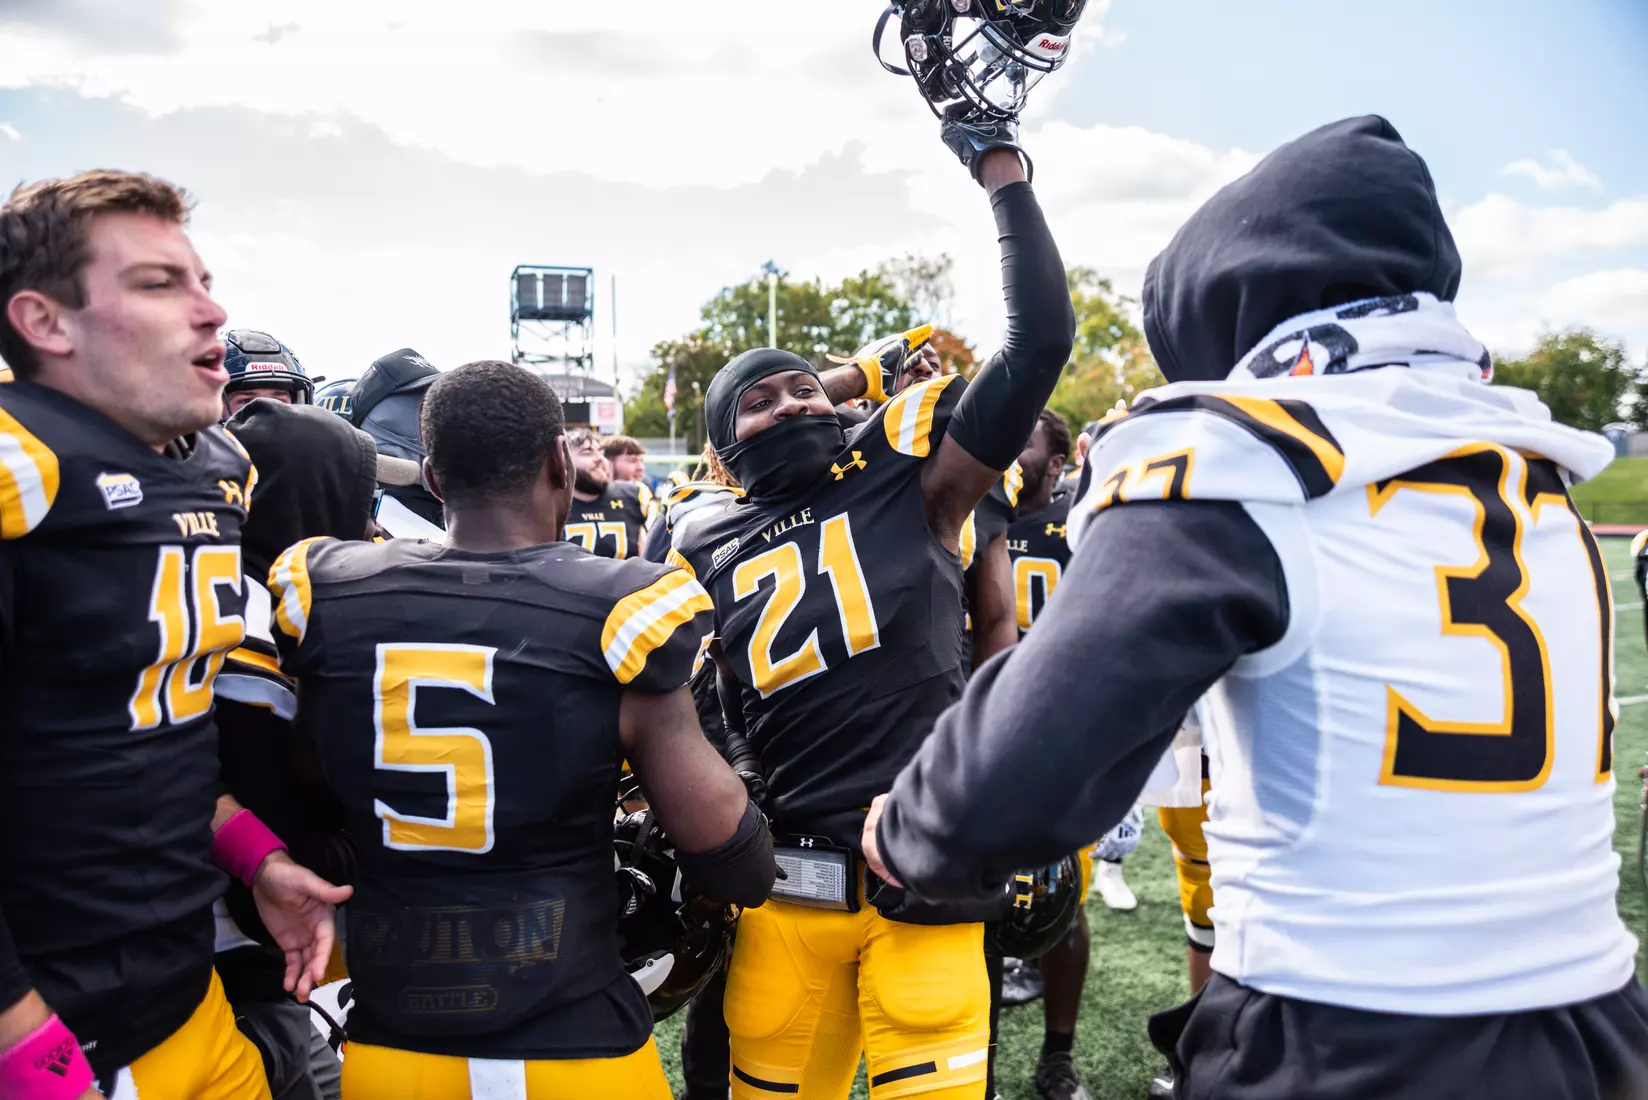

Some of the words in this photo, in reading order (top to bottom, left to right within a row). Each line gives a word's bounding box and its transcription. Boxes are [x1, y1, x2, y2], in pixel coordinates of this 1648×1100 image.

[172, 511, 221, 538] VILLE
[761, 506, 815, 543] VILLE
[713, 539, 739, 563] PSAC
[1005, 540, 1028, 552] LLE
[733, 511, 880, 699] 21
[128, 544, 247, 731] 16
[373, 642, 498, 854] 5
